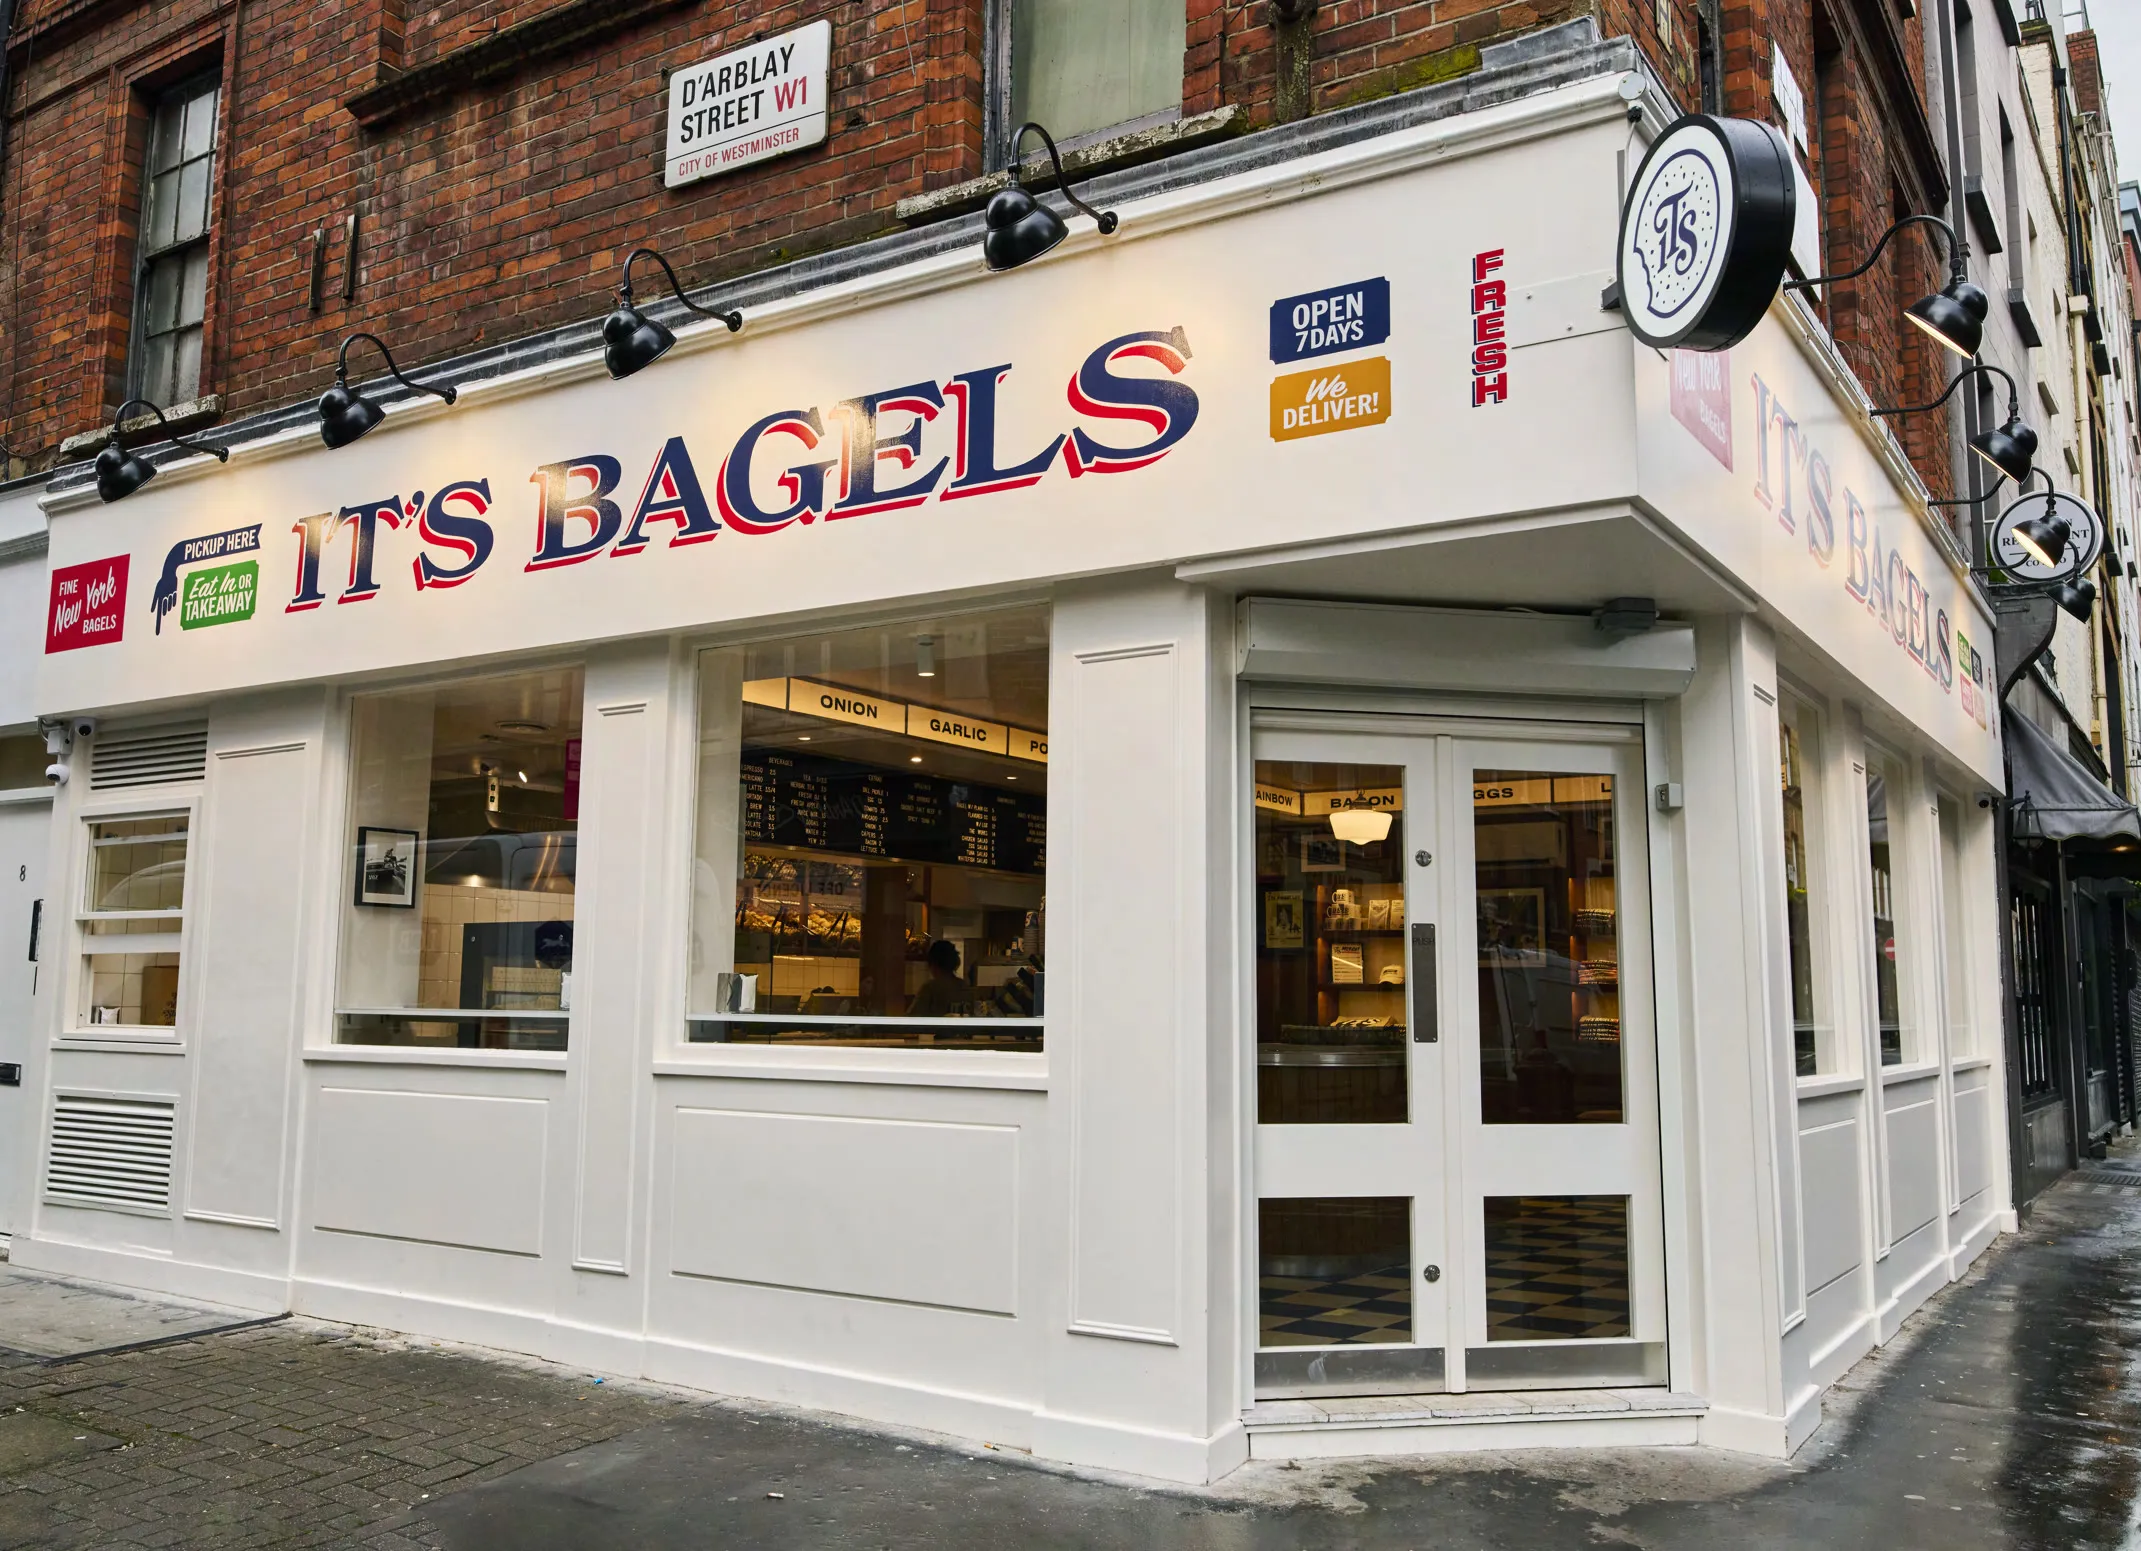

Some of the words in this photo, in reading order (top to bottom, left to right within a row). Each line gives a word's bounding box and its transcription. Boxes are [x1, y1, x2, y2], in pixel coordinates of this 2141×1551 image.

[682, 43, 795, 108] D'ARBLAY
[680, 89, 765, 144] STREET
[774, 75, 807, 113] W1
[679, 157, 702, 176] CITY
[705, 152, 718, 168] OF
[721, 127, 800, 163] WESTMINSTER
[1292, 291, 1364, 330] OPEN
[1471, 248, 1508, 408] FRESH
[1305, 373, 1348, 403] We
[1283, 392, 1379, 430] DELIVER!
[1701, 399, 1727, 443] BAGELS
[284, 476, 496, 614] IT'S
[523, 324, 1201, 574] BAGELS
[184, 536, 225, 560] PICKUP
[226, 529, 257, 552] HERE
[1751, 372, 1835, 569] IT'S
[1843, 486, 1952, 694] BAGELS
[59, 579, 79, 596] FINE
[189, 577, 218, 600] Eat
[220, 571, 236, 593] In
[238, 573, 252, 589] OR
[54, 599, 82, 637] New
[86, 566, 117, 614] York
[185, 590, 254, 621] TAKEAWAY
[82, 614, 117, 635] BAGELS
[820, 694, 878, 719] ONION
[930, 718, 987, 742] GARLIC
[748, 784, 762, 792] LATTE
[1256, 790, 1293, 807] AINBOW
[1330, 795, 1395, 809] BAON
[1473, 787, 1514, 799] GGS
[749, 802, 763, 810] BREW
[860, 845, 878, 854] LETTUCE
[19, 864, 26, 883] 8
